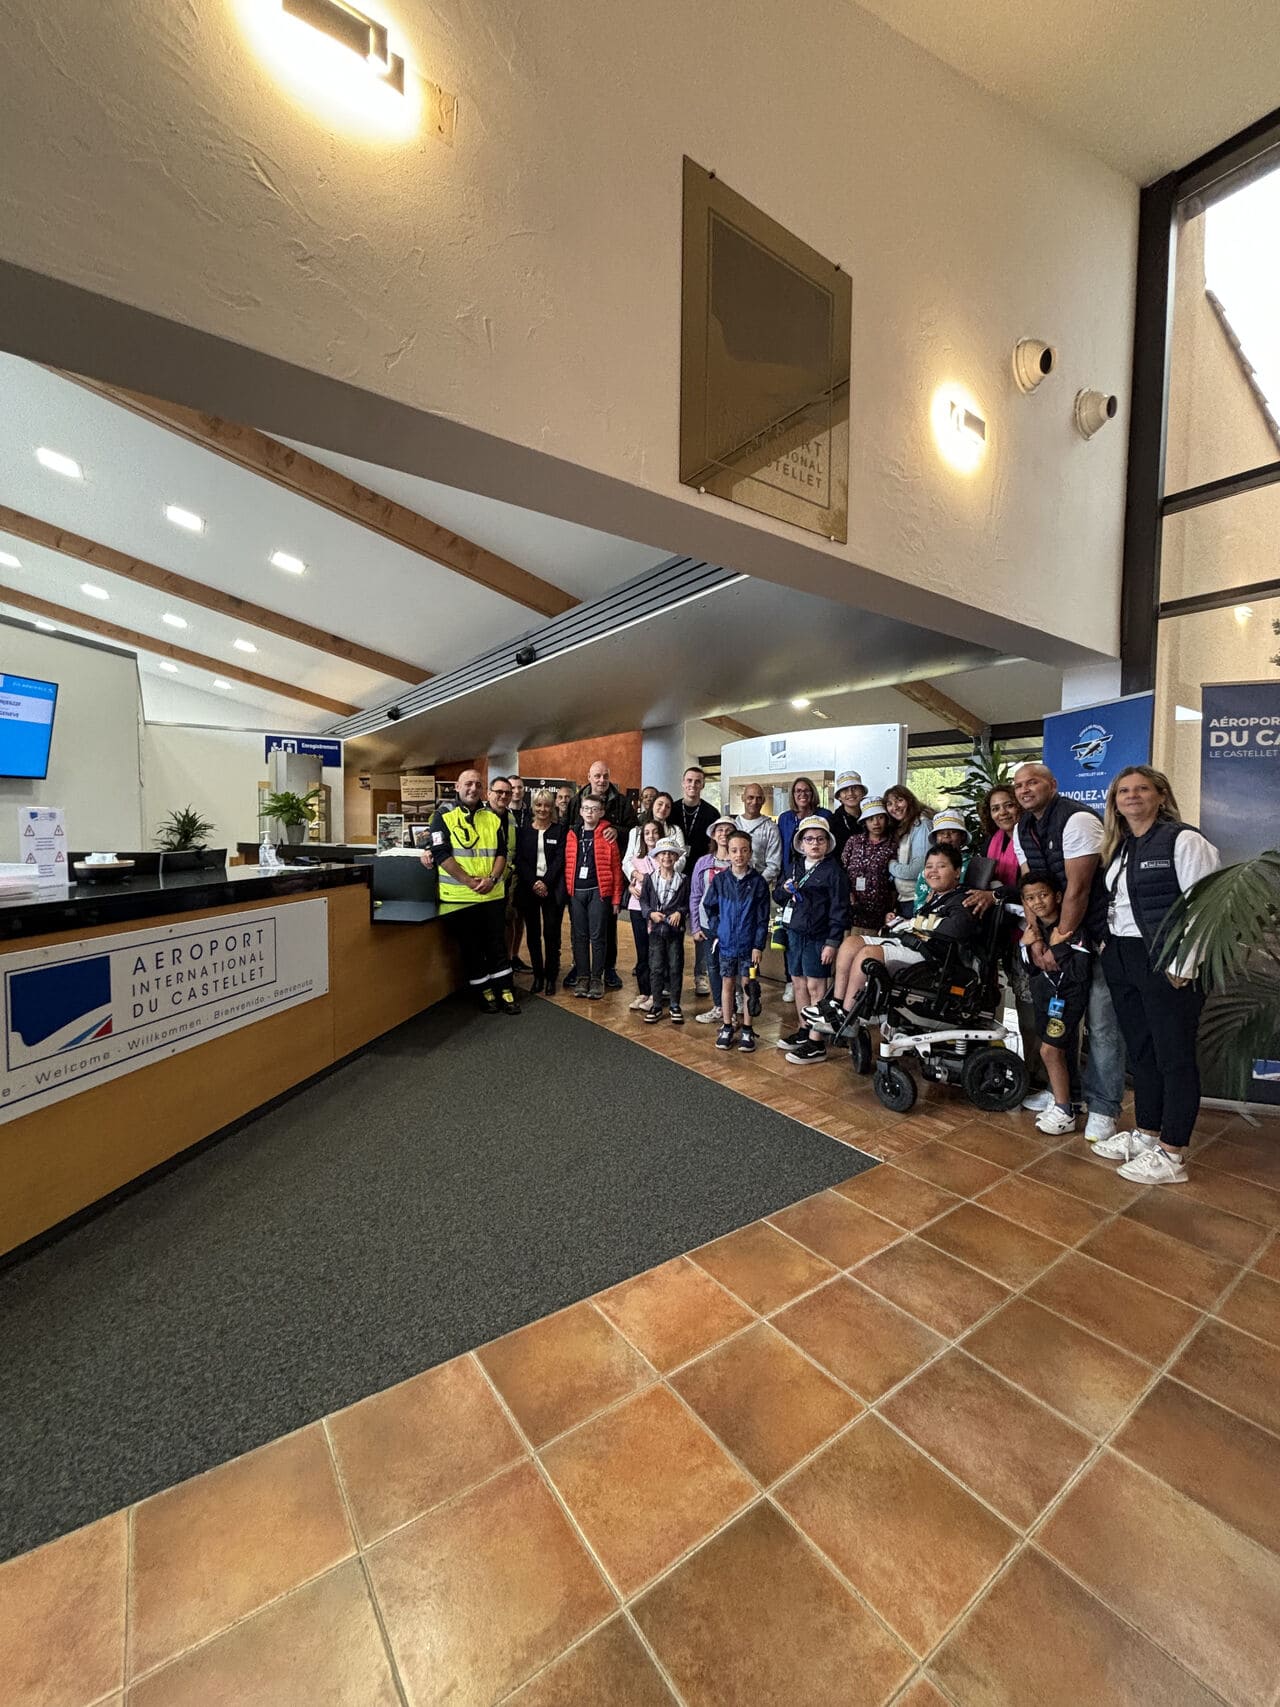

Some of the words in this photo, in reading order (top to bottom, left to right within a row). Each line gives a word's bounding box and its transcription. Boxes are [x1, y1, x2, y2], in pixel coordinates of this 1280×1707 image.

[1209, 750, 1221, 758] LE
[1223, 749, 1277, 758] CASTELLET
[1210, 730, 1249, 747] DU
[132, 929, 263, 976] AEROPORT
[132, 951, 264, 997] INTERNATIONAL
[133, 998, 158, 1019] DU
[171, 966, 264, 1006] CASTELLET
[35, 1052, 110, 1085] Welcome
[127, 1018, 202, 1051] Willkommen
[213, 996, 265, 1020] Bienvenido
